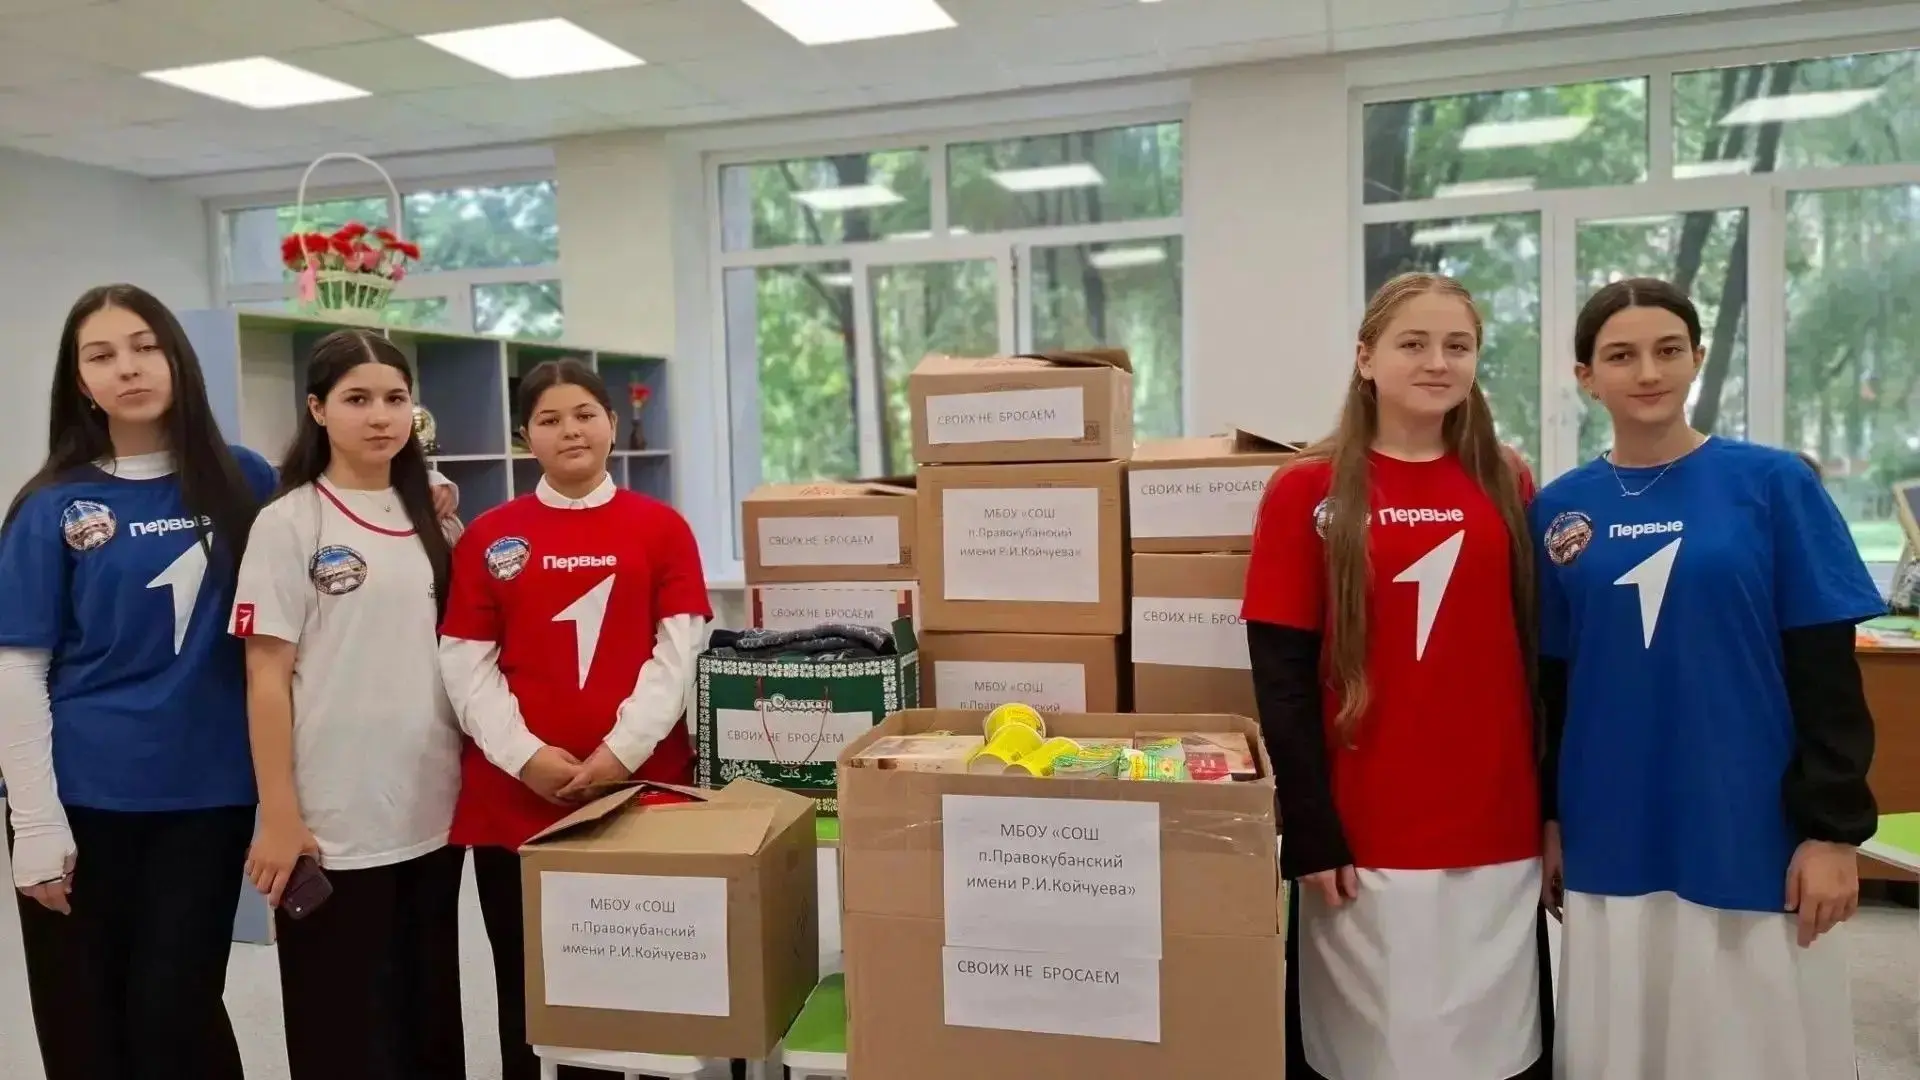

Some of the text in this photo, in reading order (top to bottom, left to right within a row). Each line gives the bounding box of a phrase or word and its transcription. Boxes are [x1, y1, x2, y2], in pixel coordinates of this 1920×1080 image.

[936, 407, 1056, 426] СВОИХ НЕ БРОСАЕМ
[1140, 483, 1182, 496] СВОИХ
[1185, 482, 1203, 494] НЕ
[983, 507, 1056, 519] МБОУ «СОШ
[1378, 507, 1464, 528] Первые
[128, 514, 212, 537] Первые
[968, 526, 1073, 540] п.Правокубанский
[1608, 519, 1684, 539] Первые
[768, 534, 874, 546] СВОИХ НЕ БРОСАЕМ
[960, 547, 996, 558] имени
[542, 554, 617, 573] Первые
[770, 607, 874, 620] СВОИХ НЕ БРОСАЕМ
[1143, 610, 1185, 623] СВОИХ
[1188, 611, 1204, 624] НЕ
[974, 680, 1044, 693] МБОУ «СОШ
[727, 729, 844, 744] СВОИХ НЕ БРОСАЕМ
[1000, 823, 1099, 841] МБОУ «СОШ
[979, 849, 1123, 868] п.Правокубанский
[966, 877, 1136, 897] имени Р.И.Койчуева»
[590, 898, 676, 913] МБОУ «СОШ
[571, 920, 696, 938] п.Правокубанский
[562, 944, 707, 962] имени Р.И.Койчуева»
[957, 959, 1120, 985] СВОИХ НЕ БРОСАЕМ
